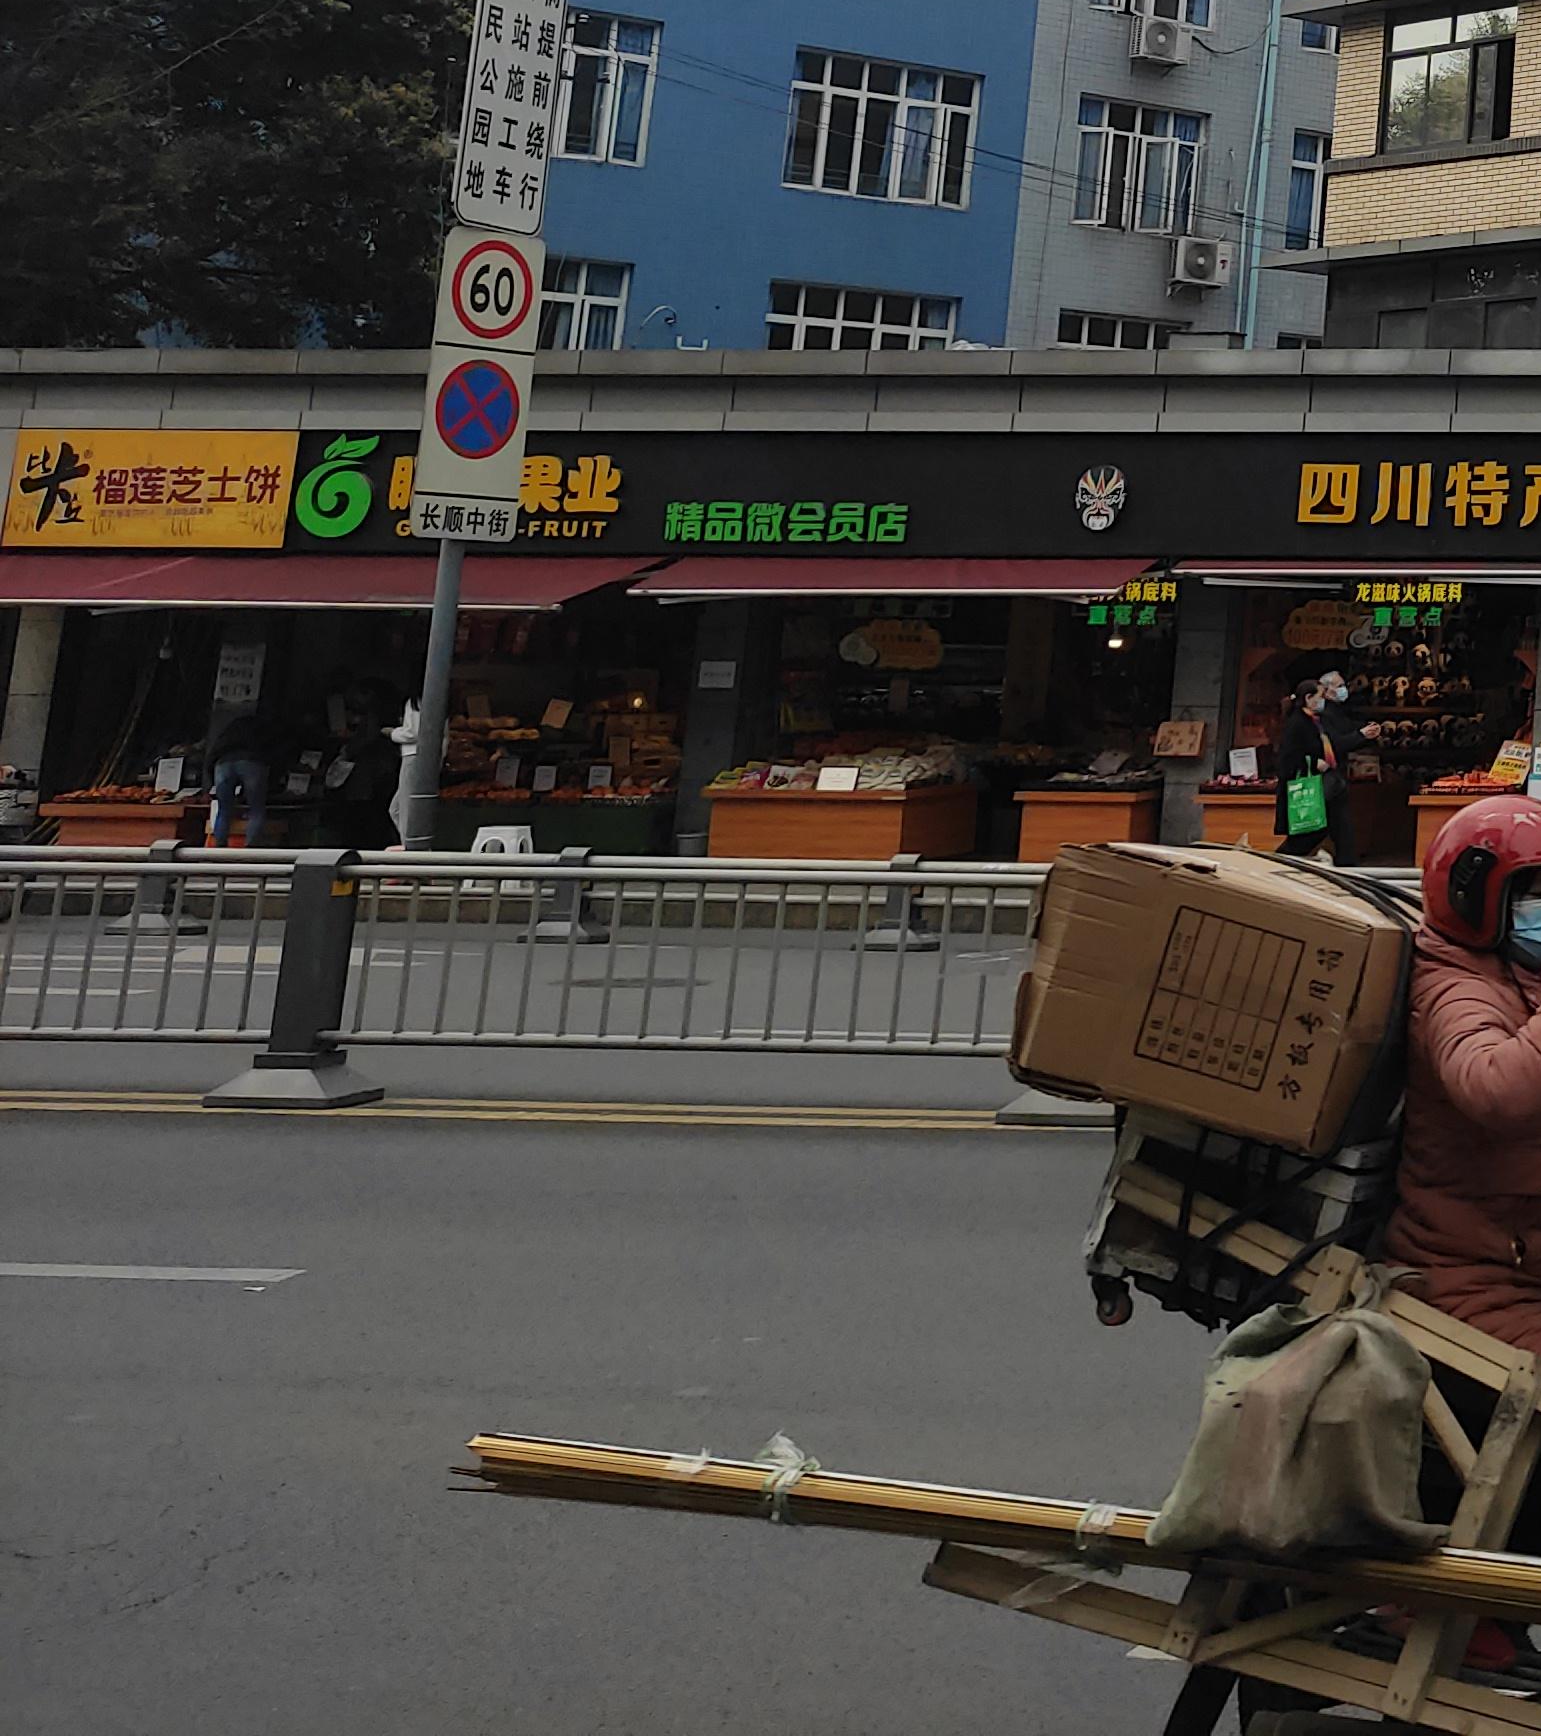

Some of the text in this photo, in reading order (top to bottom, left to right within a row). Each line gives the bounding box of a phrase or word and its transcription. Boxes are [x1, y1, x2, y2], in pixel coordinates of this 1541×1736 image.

[469, 264, 516, 316] 60
[92, 465, 282, 505] 榴莲芝士饼
[420, 503, 509, 537] 长顺中街
[663, 501, 909, 544] 精品微会员店
[1372, 606, 1443, 627] 直营点
